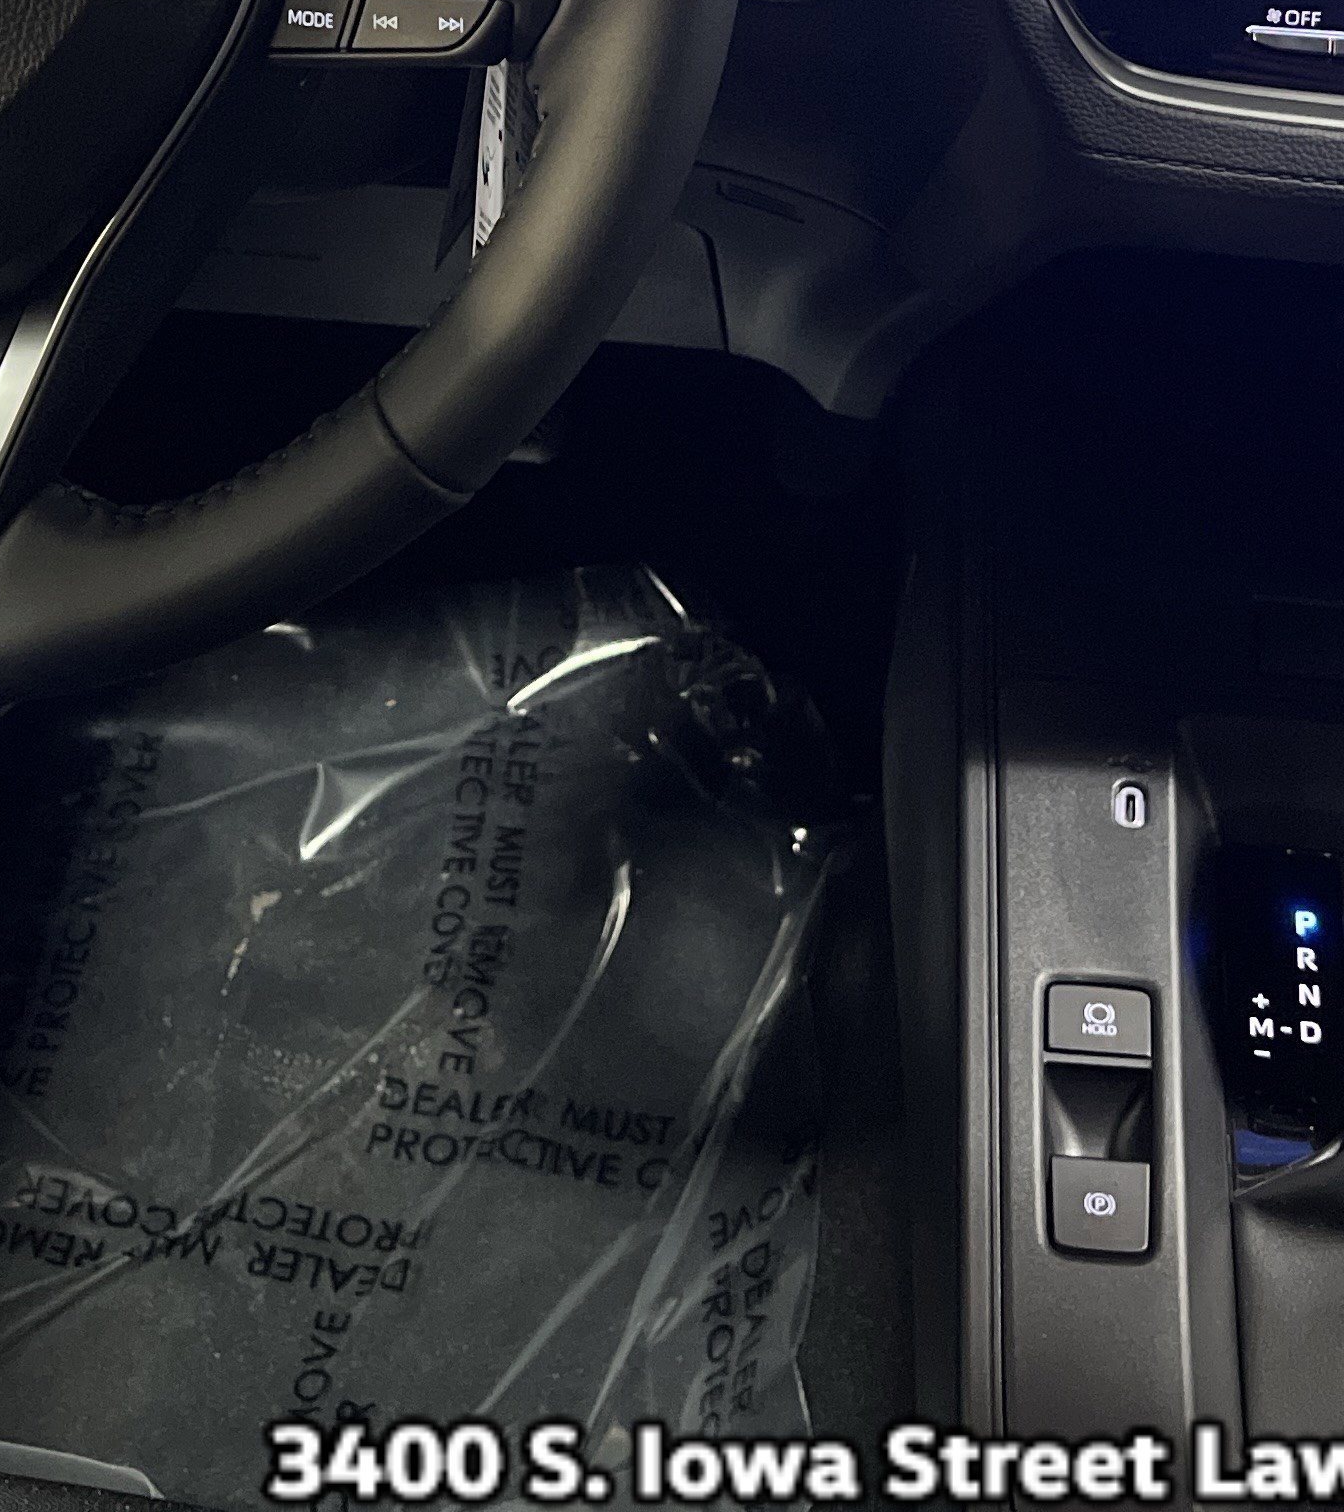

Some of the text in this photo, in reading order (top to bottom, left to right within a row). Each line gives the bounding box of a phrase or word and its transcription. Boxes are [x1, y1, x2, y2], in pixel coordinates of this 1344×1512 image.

[287, 8, 334, 29] MODE
[1285, 10, 1322, 28] OFF
[1294, 909, 1318, 935] P
[1296, 947, 1319, 972] R
[1299, 983, 1322, 1008] N
[1081, 1023, 1118, 1037] HOLD
[1248, 1017, 1323, 1044] M D
[378, 1074, 676, 1147] DEALER MUST
[364, 1123, 623, 1188] PROTECTIVE
[246, 1240, 412, 1294] DEALER
